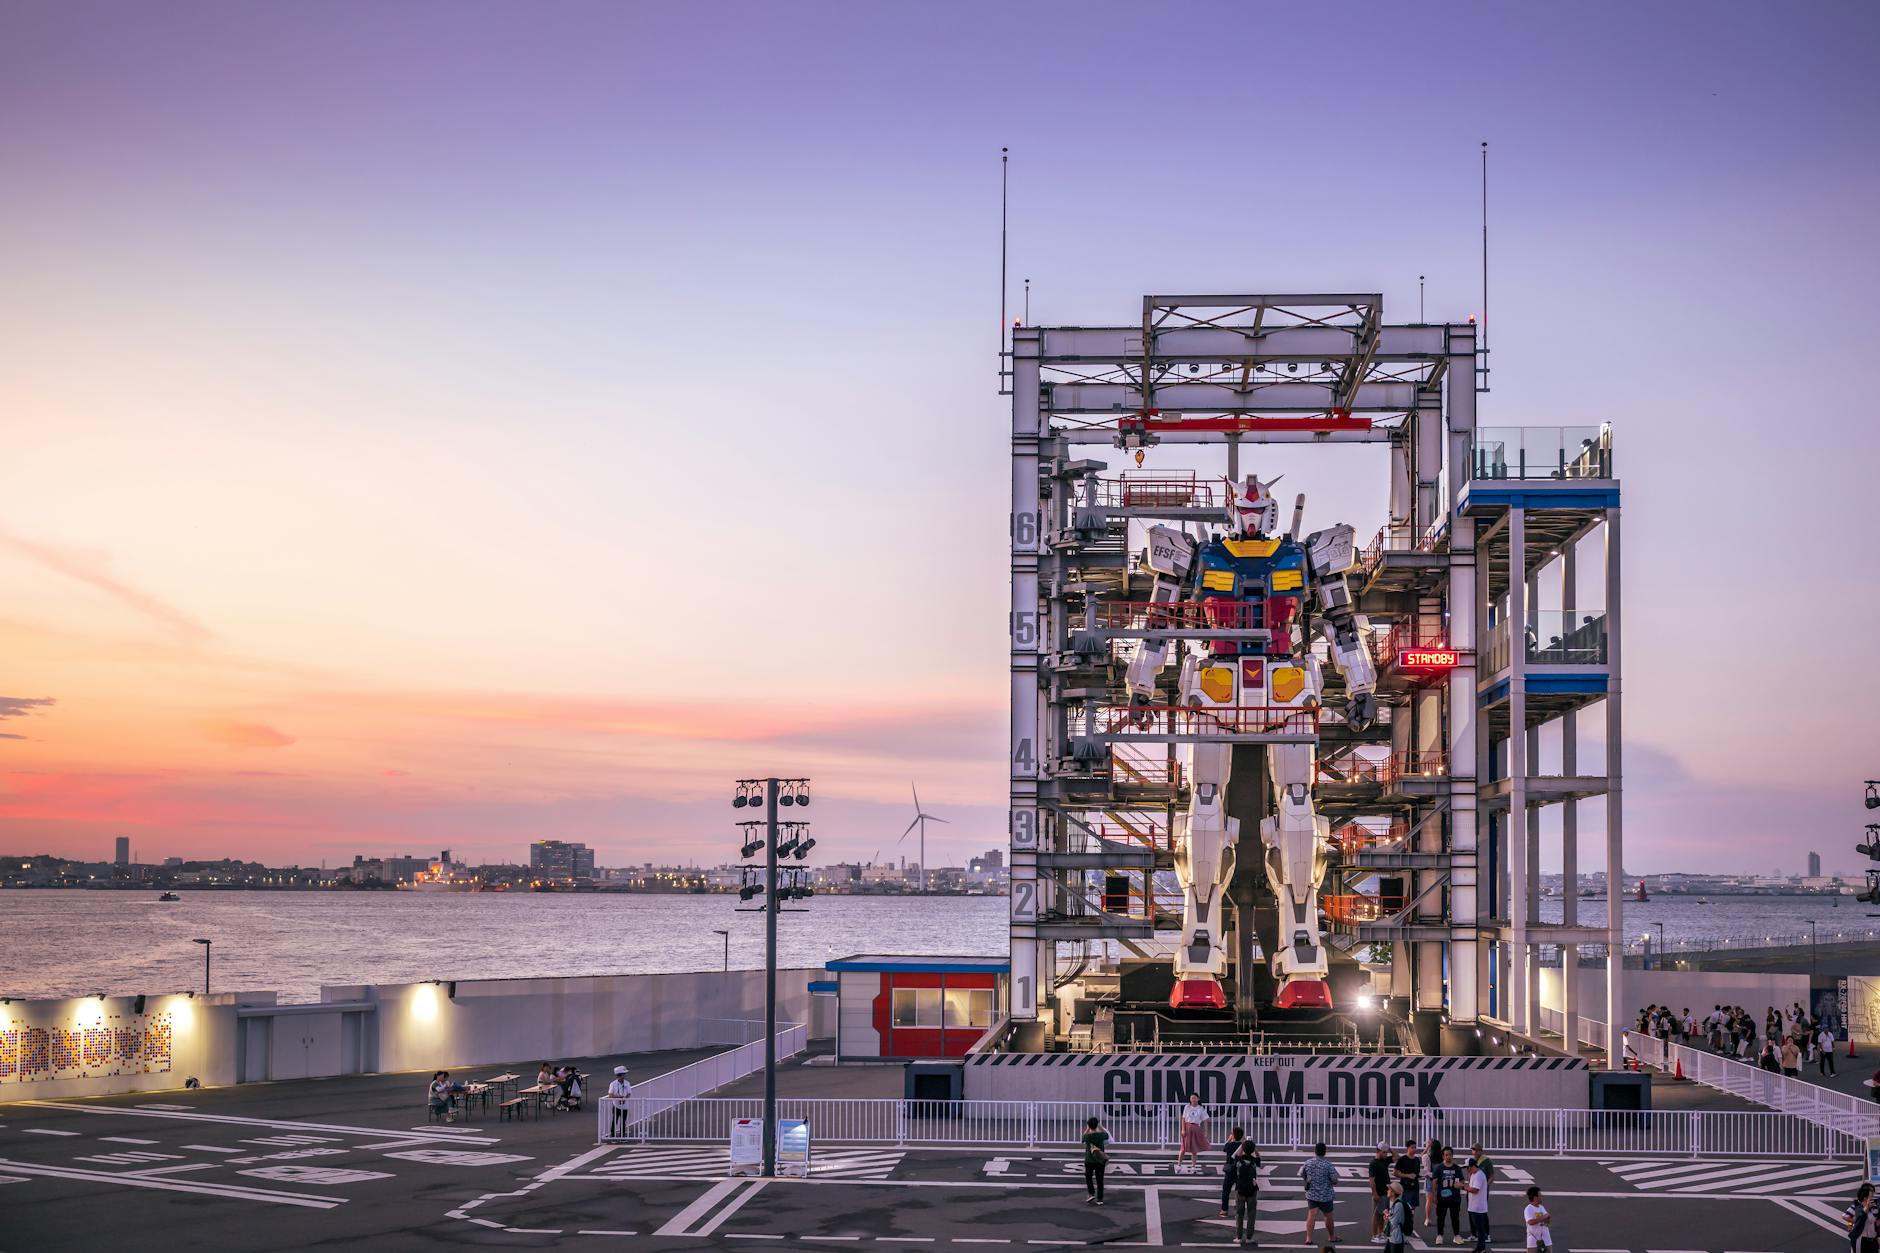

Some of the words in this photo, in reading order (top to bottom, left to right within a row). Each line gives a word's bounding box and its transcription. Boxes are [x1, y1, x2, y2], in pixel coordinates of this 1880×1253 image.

[1016, 511, 1035, 545] 6
[1153, 545, 1176, 561] EFSF
[1016, 611, 1034, 645] 5
[1407, 653, 1455, 665] STANDBY
[1014, 738, 1035, 771] 4
[1015, 809, 1034, 843] 3
[1014, 882, 1033, 916] 2
[1017, 975, 1030, 1009] 1
[1254, 1057, 1274, 1068] KEEP
[1278, 1057, 1296, 1068] OUT
[1103, 1069, 1446, 1120] GUNDAM-DOCK
